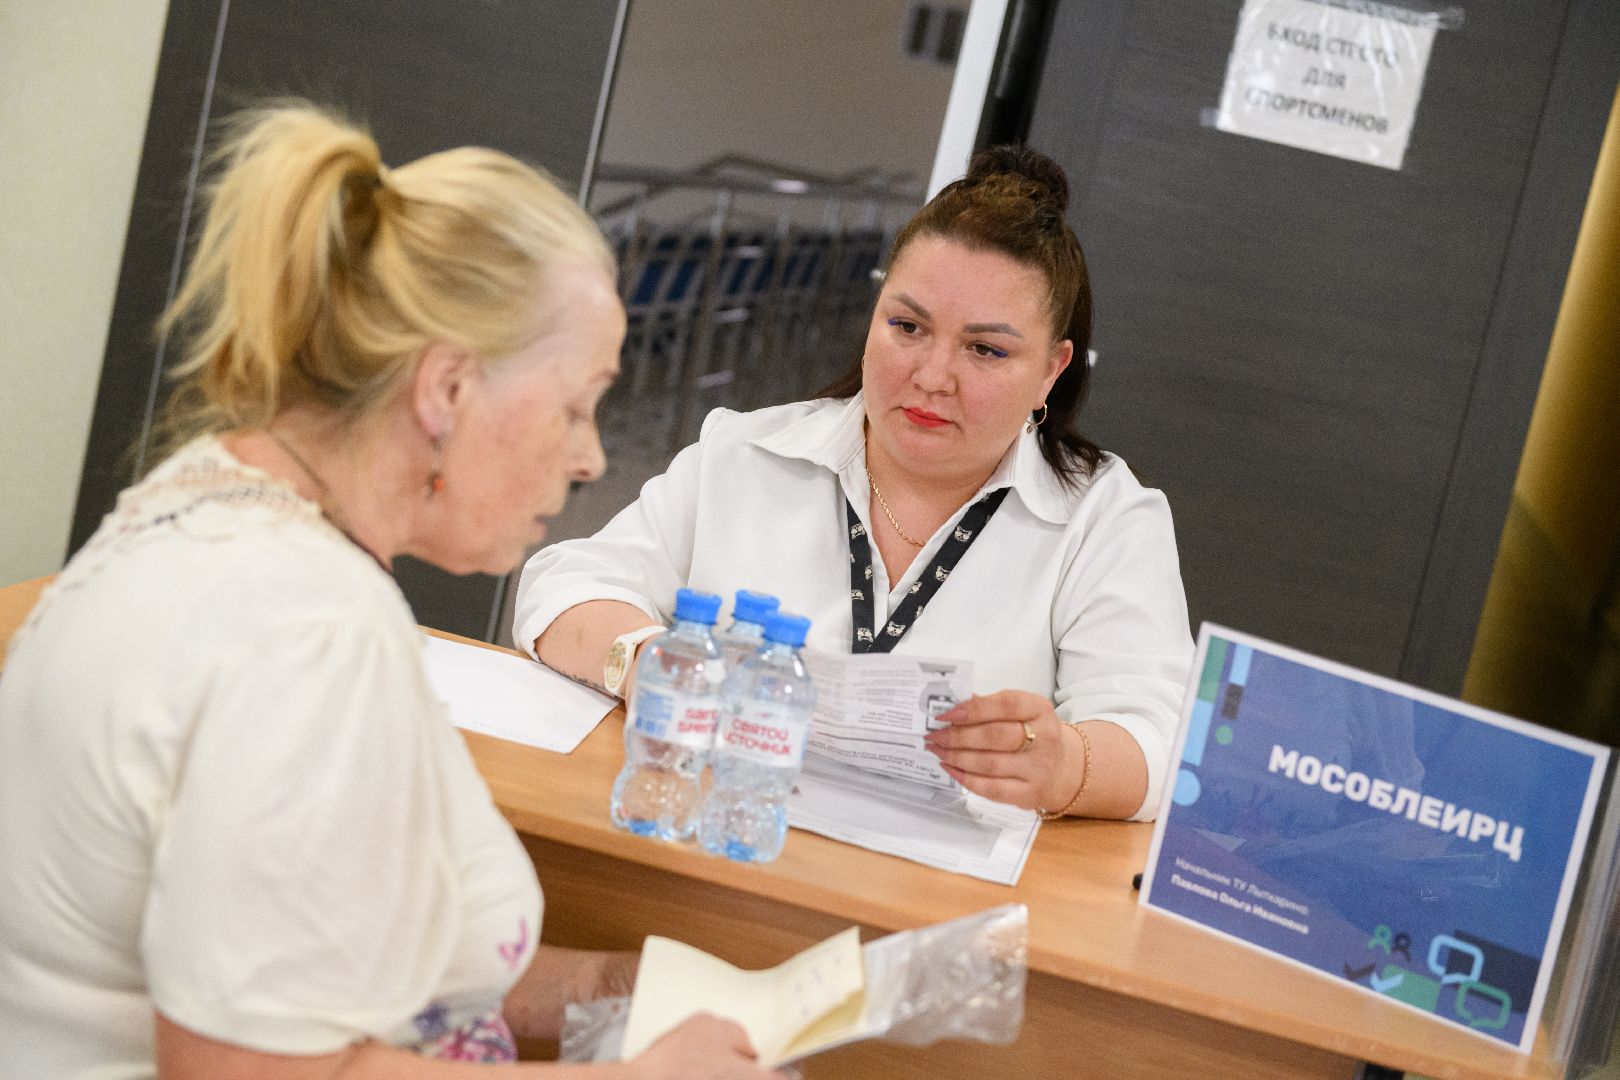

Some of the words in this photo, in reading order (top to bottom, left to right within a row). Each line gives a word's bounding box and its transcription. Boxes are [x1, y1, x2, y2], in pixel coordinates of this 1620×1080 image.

[1302, 66, 1346, 89] ДЛЯ
[1268, 744, 1525, 862] МОСОБЛЕИРЦ
[1233, 877, 1247, 891] ТУ
